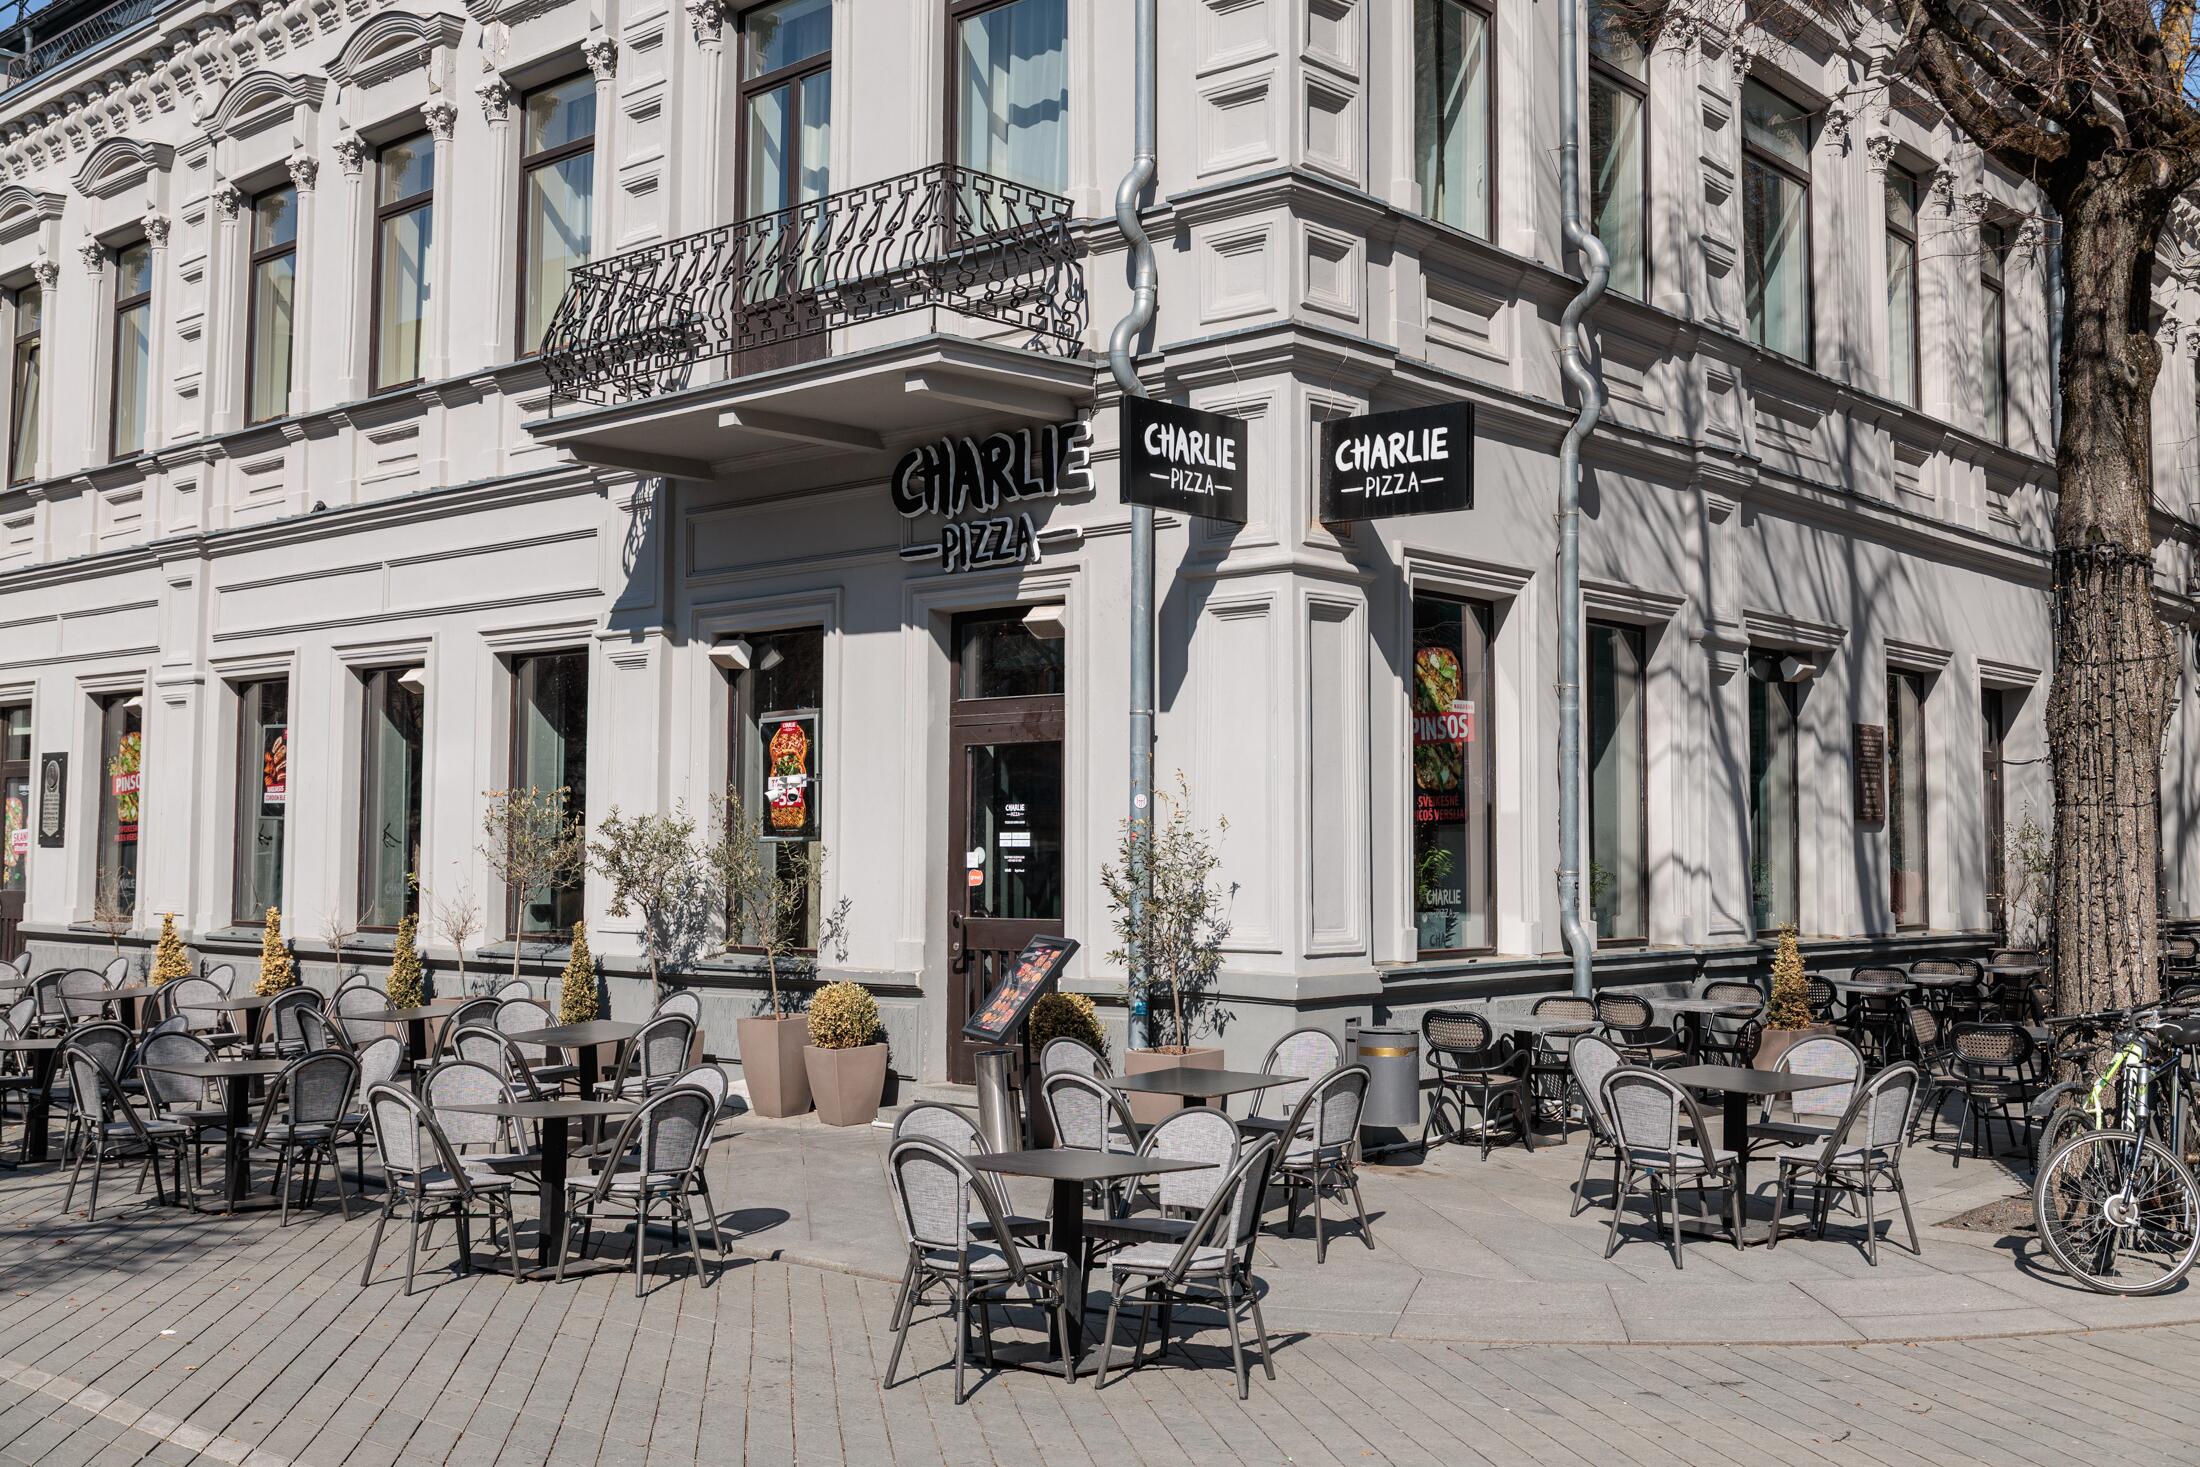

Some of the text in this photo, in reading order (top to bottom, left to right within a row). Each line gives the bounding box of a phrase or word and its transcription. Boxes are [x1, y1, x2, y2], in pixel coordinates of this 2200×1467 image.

[1144, 423, 1236, 471] CHARLIE
[1335, 427, 1449, 472] CHARLIE
[891, 421, 1095, 519] CHARLIE
[1171, 467, 1214, 496] PIZZA
[1365, 471, 1419, 498] PIZZA
[942, 512, 1041, 573] PIZZA
[1412, 714, 1469, 741] PINSOS
[1426, 889, 1461, 906] CHARLIE
